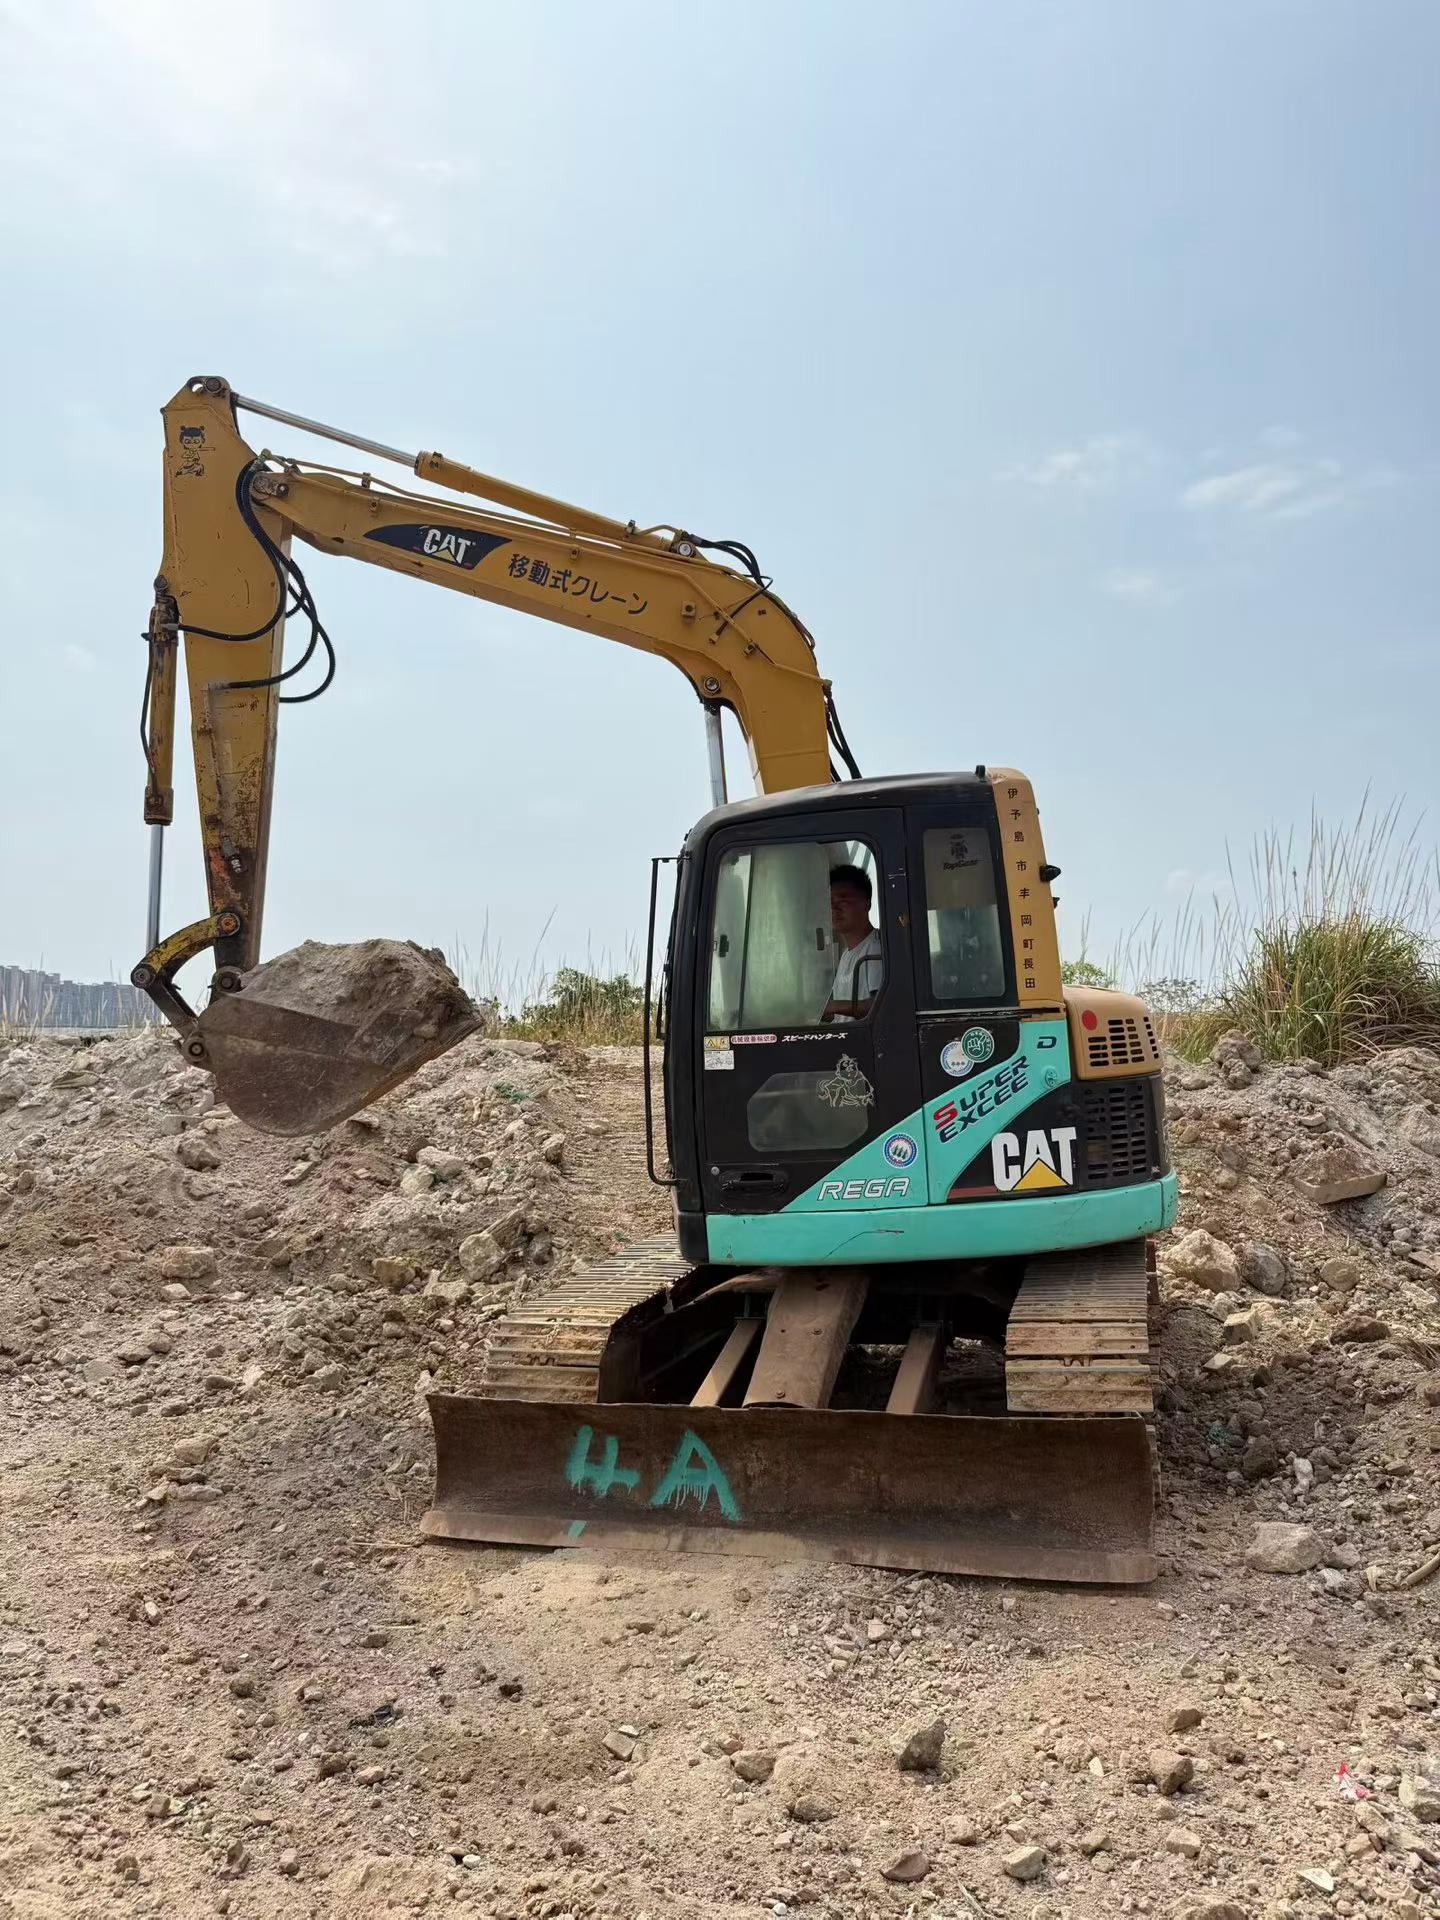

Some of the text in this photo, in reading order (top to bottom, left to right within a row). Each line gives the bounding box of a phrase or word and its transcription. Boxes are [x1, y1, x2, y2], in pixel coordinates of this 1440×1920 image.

[423, 528, 471, 565] CAT
[508, 553, 648, 614] 移動式クレーン
[1037, 1036, 1057, 1049] D
[933, 1055, 1029, 1130] SUPER
[940, 1072, 1028, 1142] EXCEE
[817, 1176, 910, 1201] REGA
[991, 1126, 1077, 1191] CAT
